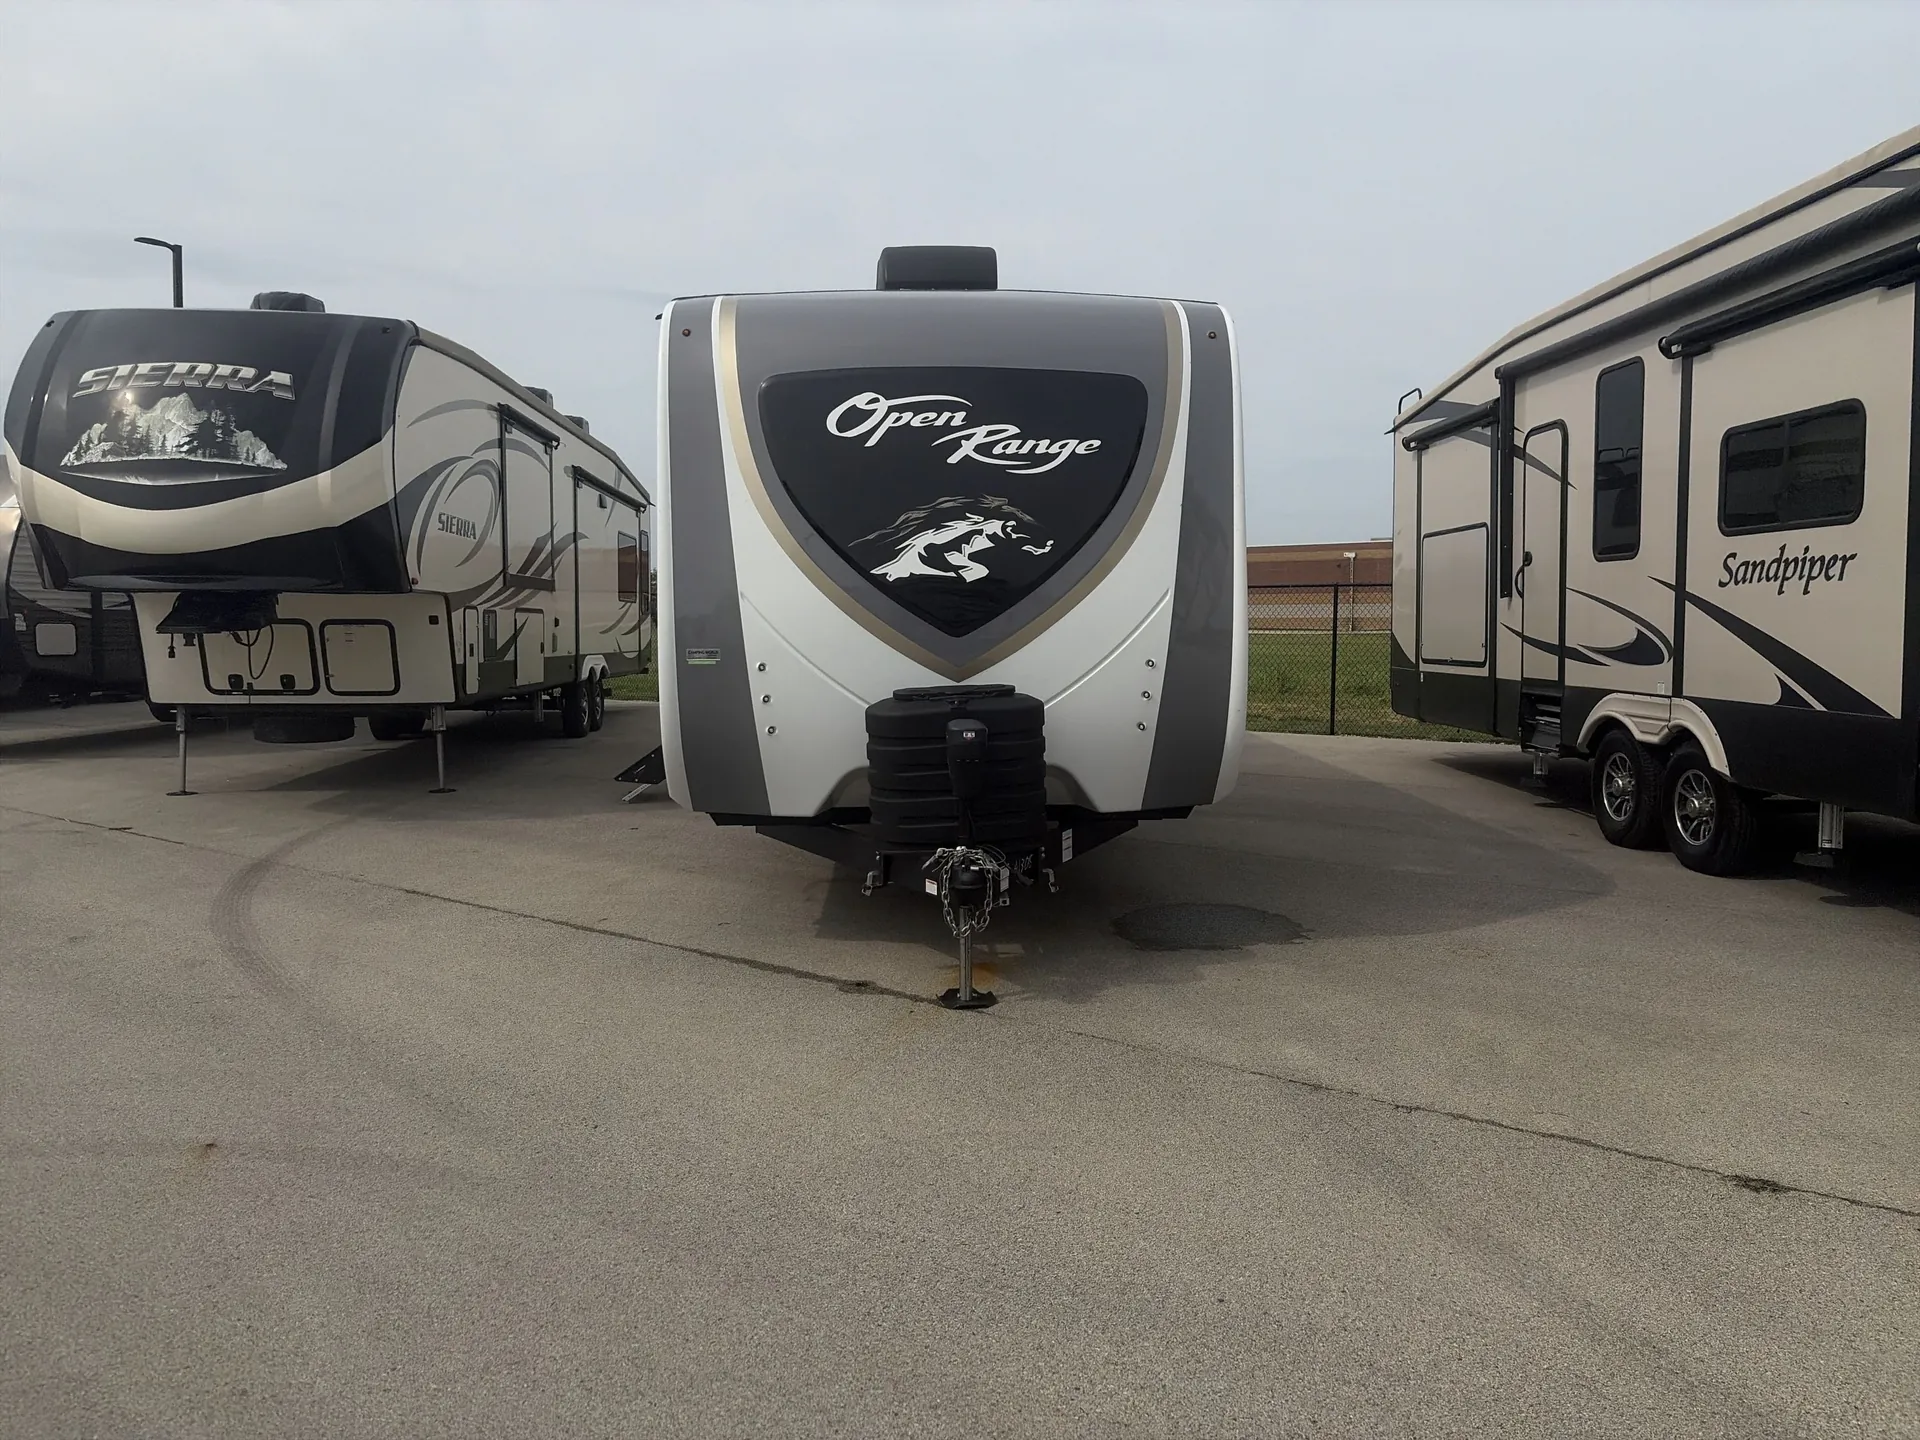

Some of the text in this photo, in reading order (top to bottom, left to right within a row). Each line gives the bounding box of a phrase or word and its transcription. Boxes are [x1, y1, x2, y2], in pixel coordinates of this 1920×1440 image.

[72, 361, 296, 401] SIERRA
[826, 391, 973, 448] Open
[931, 423, 1102, 474] Range
[437, 511, 477, 540] SIERRA
[1718, 543, 1858, 596] Sandpiper
